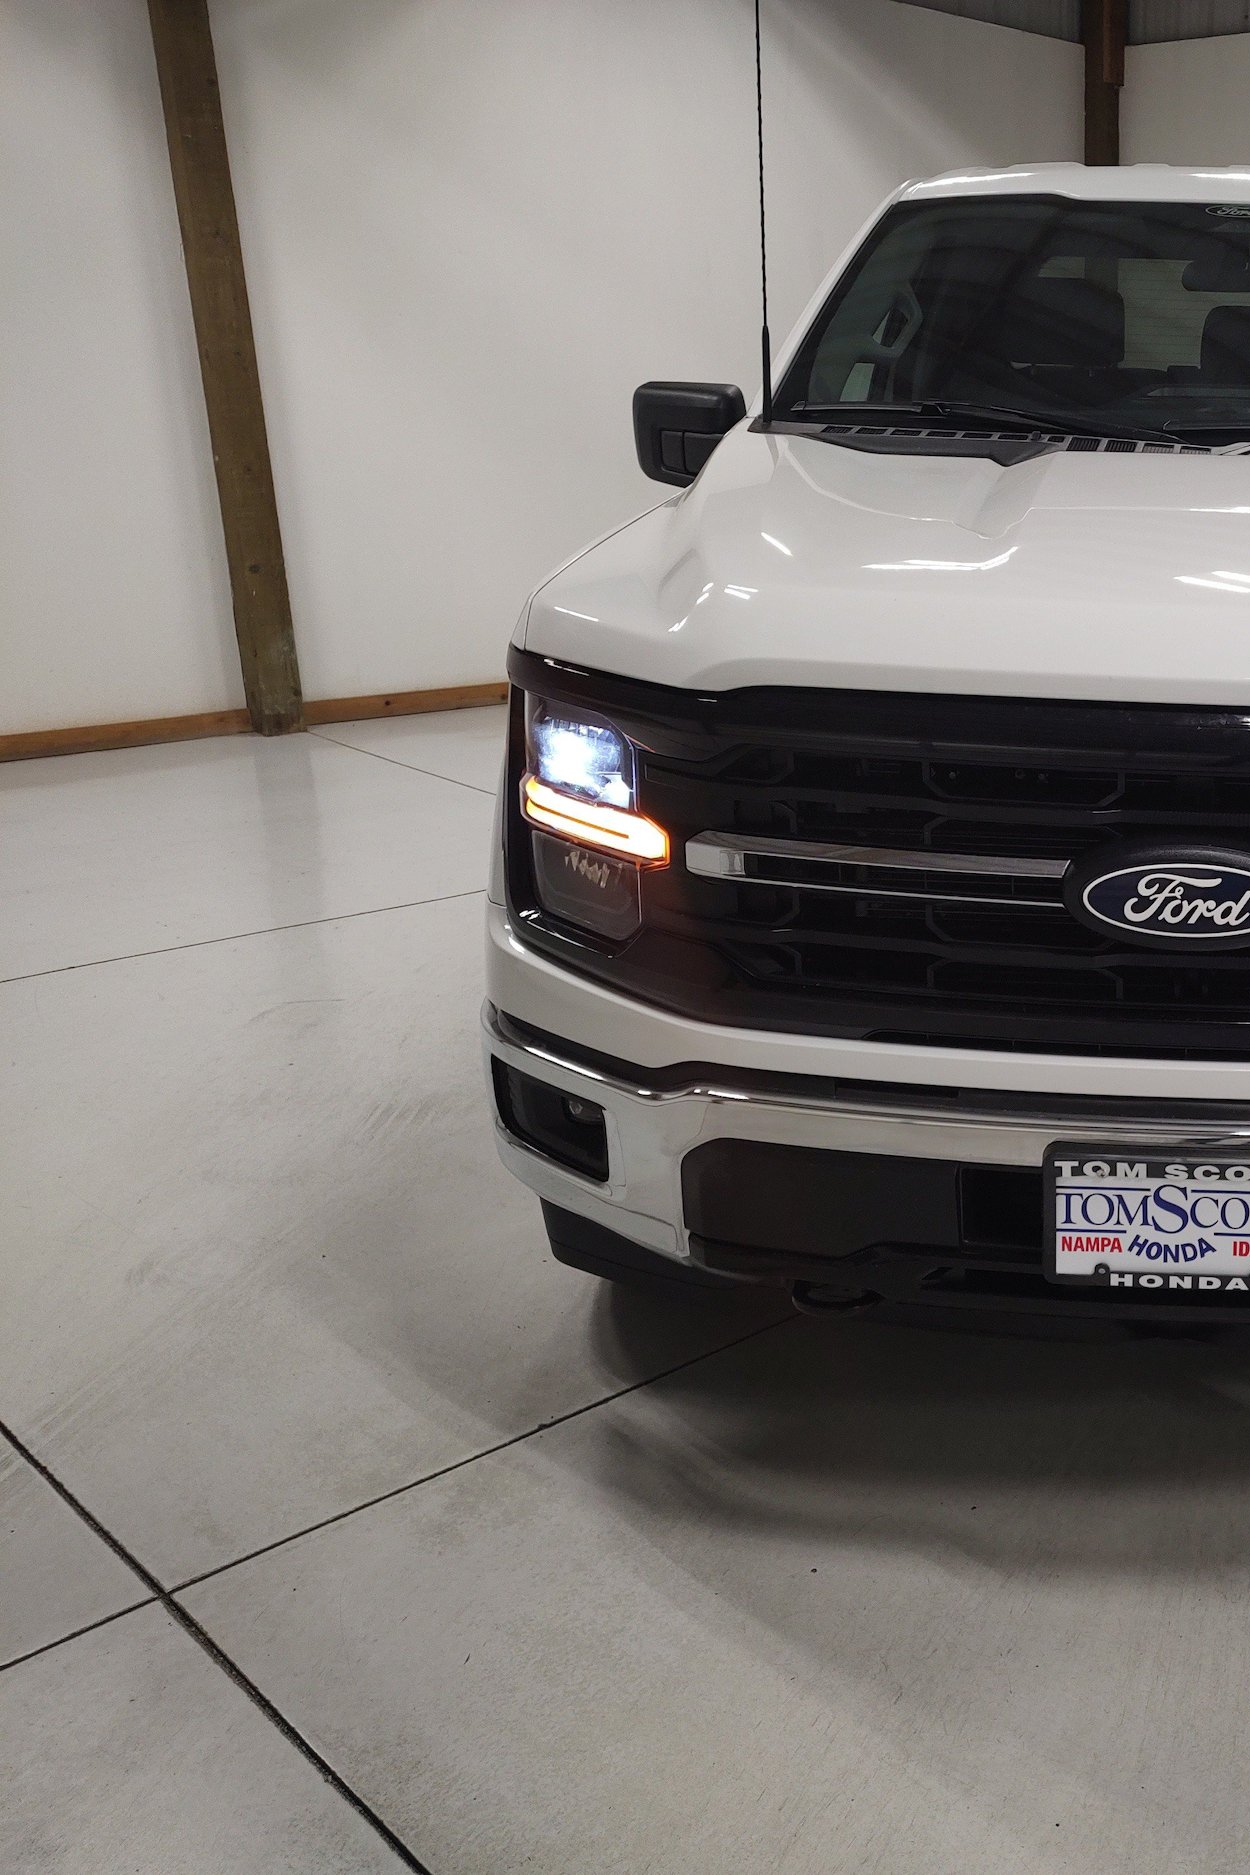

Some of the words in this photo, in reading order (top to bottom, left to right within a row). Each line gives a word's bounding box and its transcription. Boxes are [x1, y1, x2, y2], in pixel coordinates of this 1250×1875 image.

[1053, 1160, 1149, 1179] TOM
[1061, 1236, 1123, 1253] NAMPA
[1127, 1234, 1217, 1263] HONDA
[1109, 1273, 1249, 1291] HONDA
